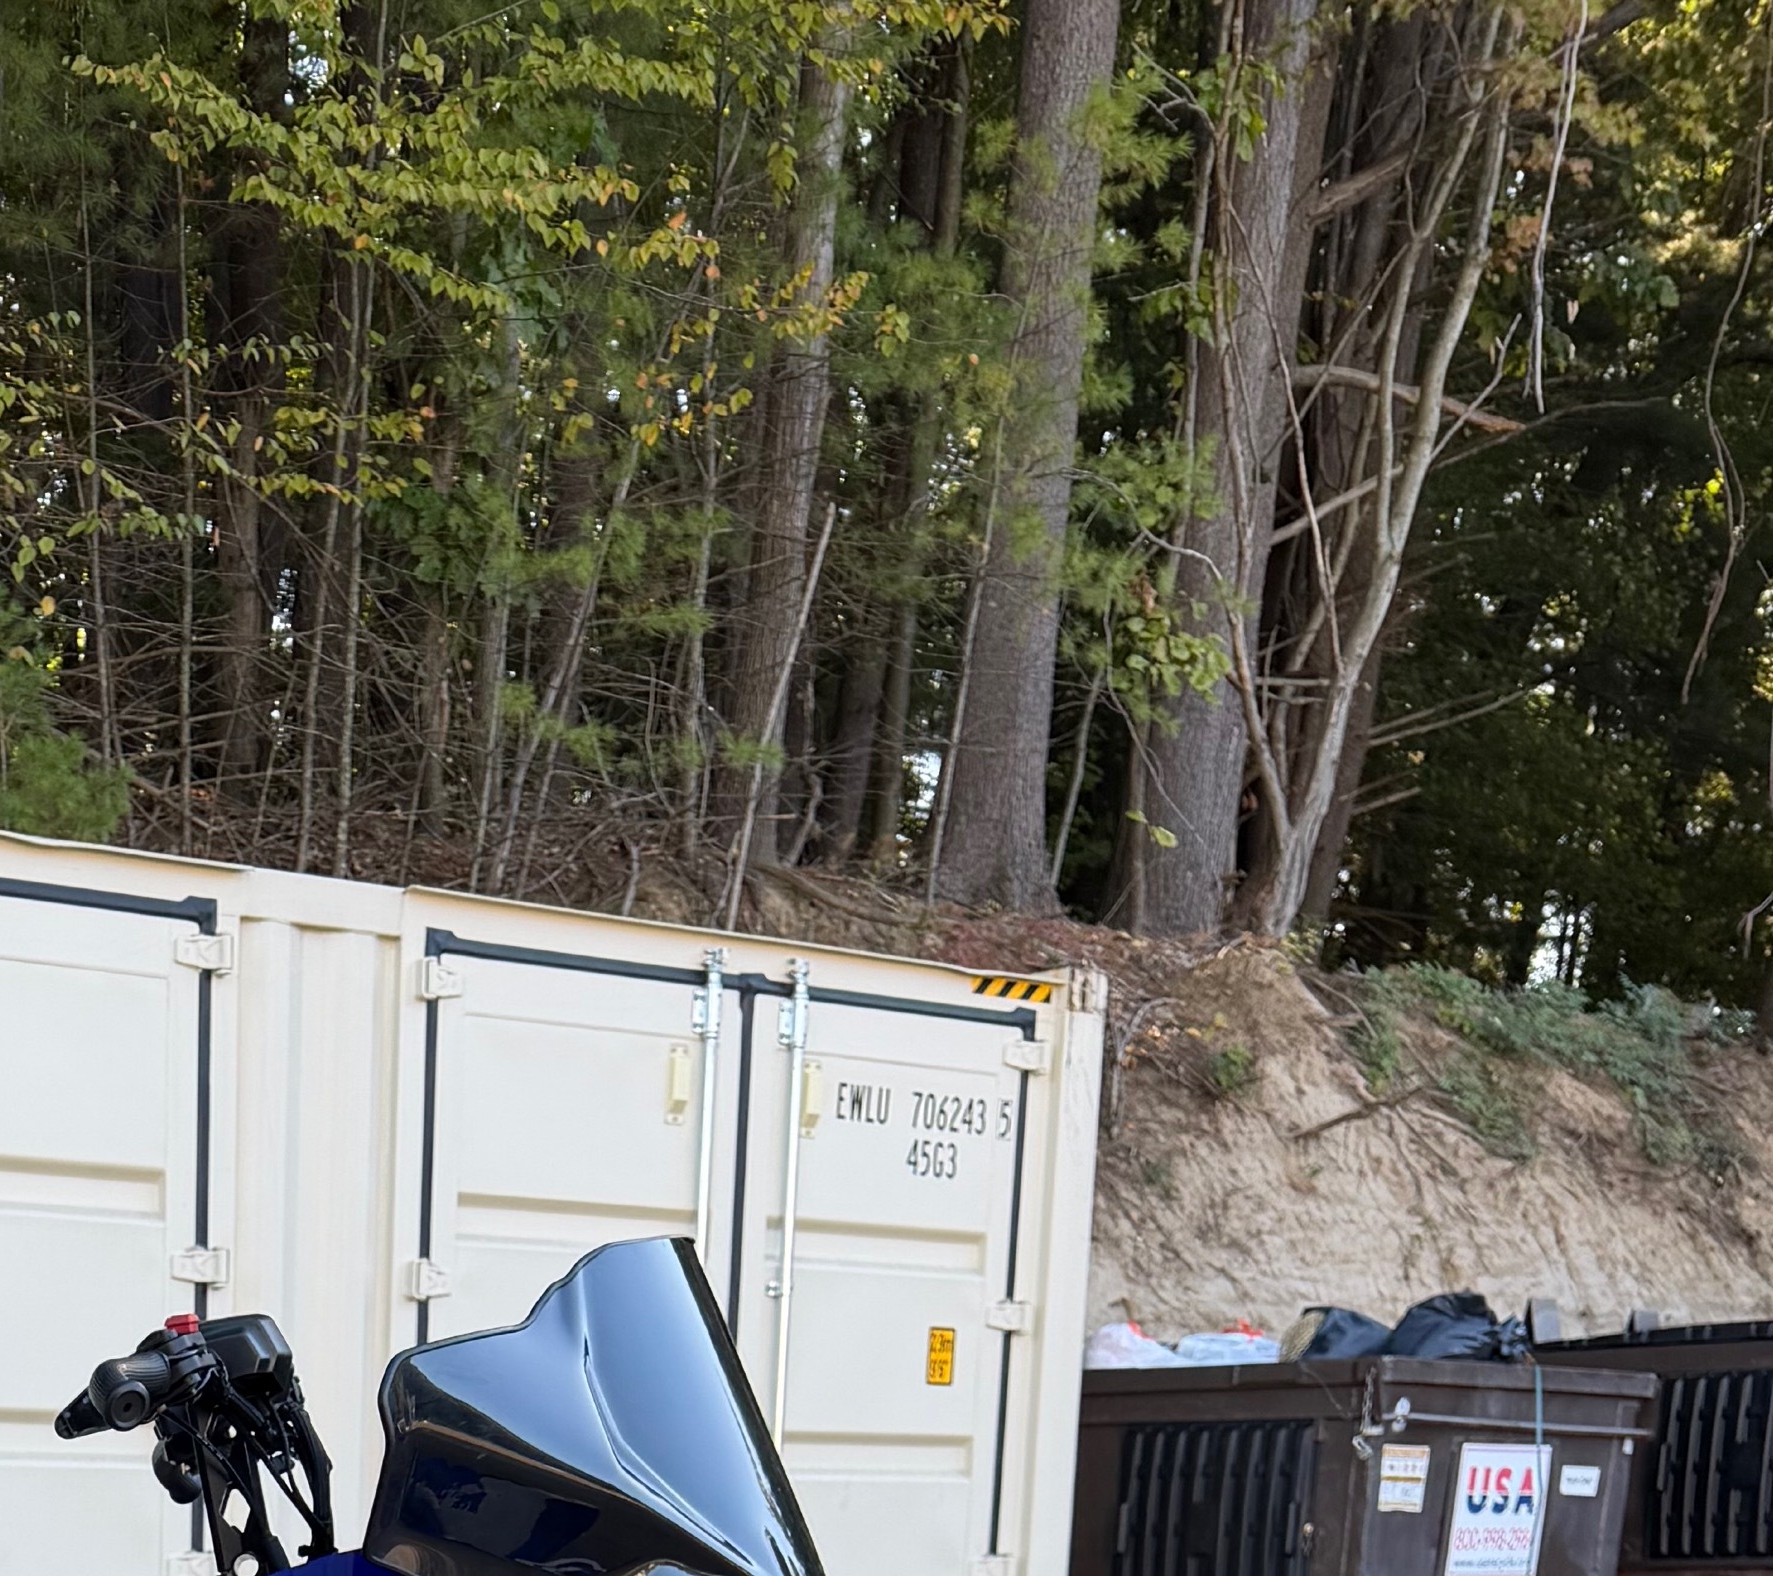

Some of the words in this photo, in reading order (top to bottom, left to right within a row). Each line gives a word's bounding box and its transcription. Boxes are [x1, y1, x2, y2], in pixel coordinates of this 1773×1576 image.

[835, 1082, 891, 1125] EWLU
[911, 1091, 988, 1136] 706243
[998, 1101, 1012, 1138] 5
[905, 1138, 959, 1179] 45G3
[1467, 1466, 1534, 1514] USA
